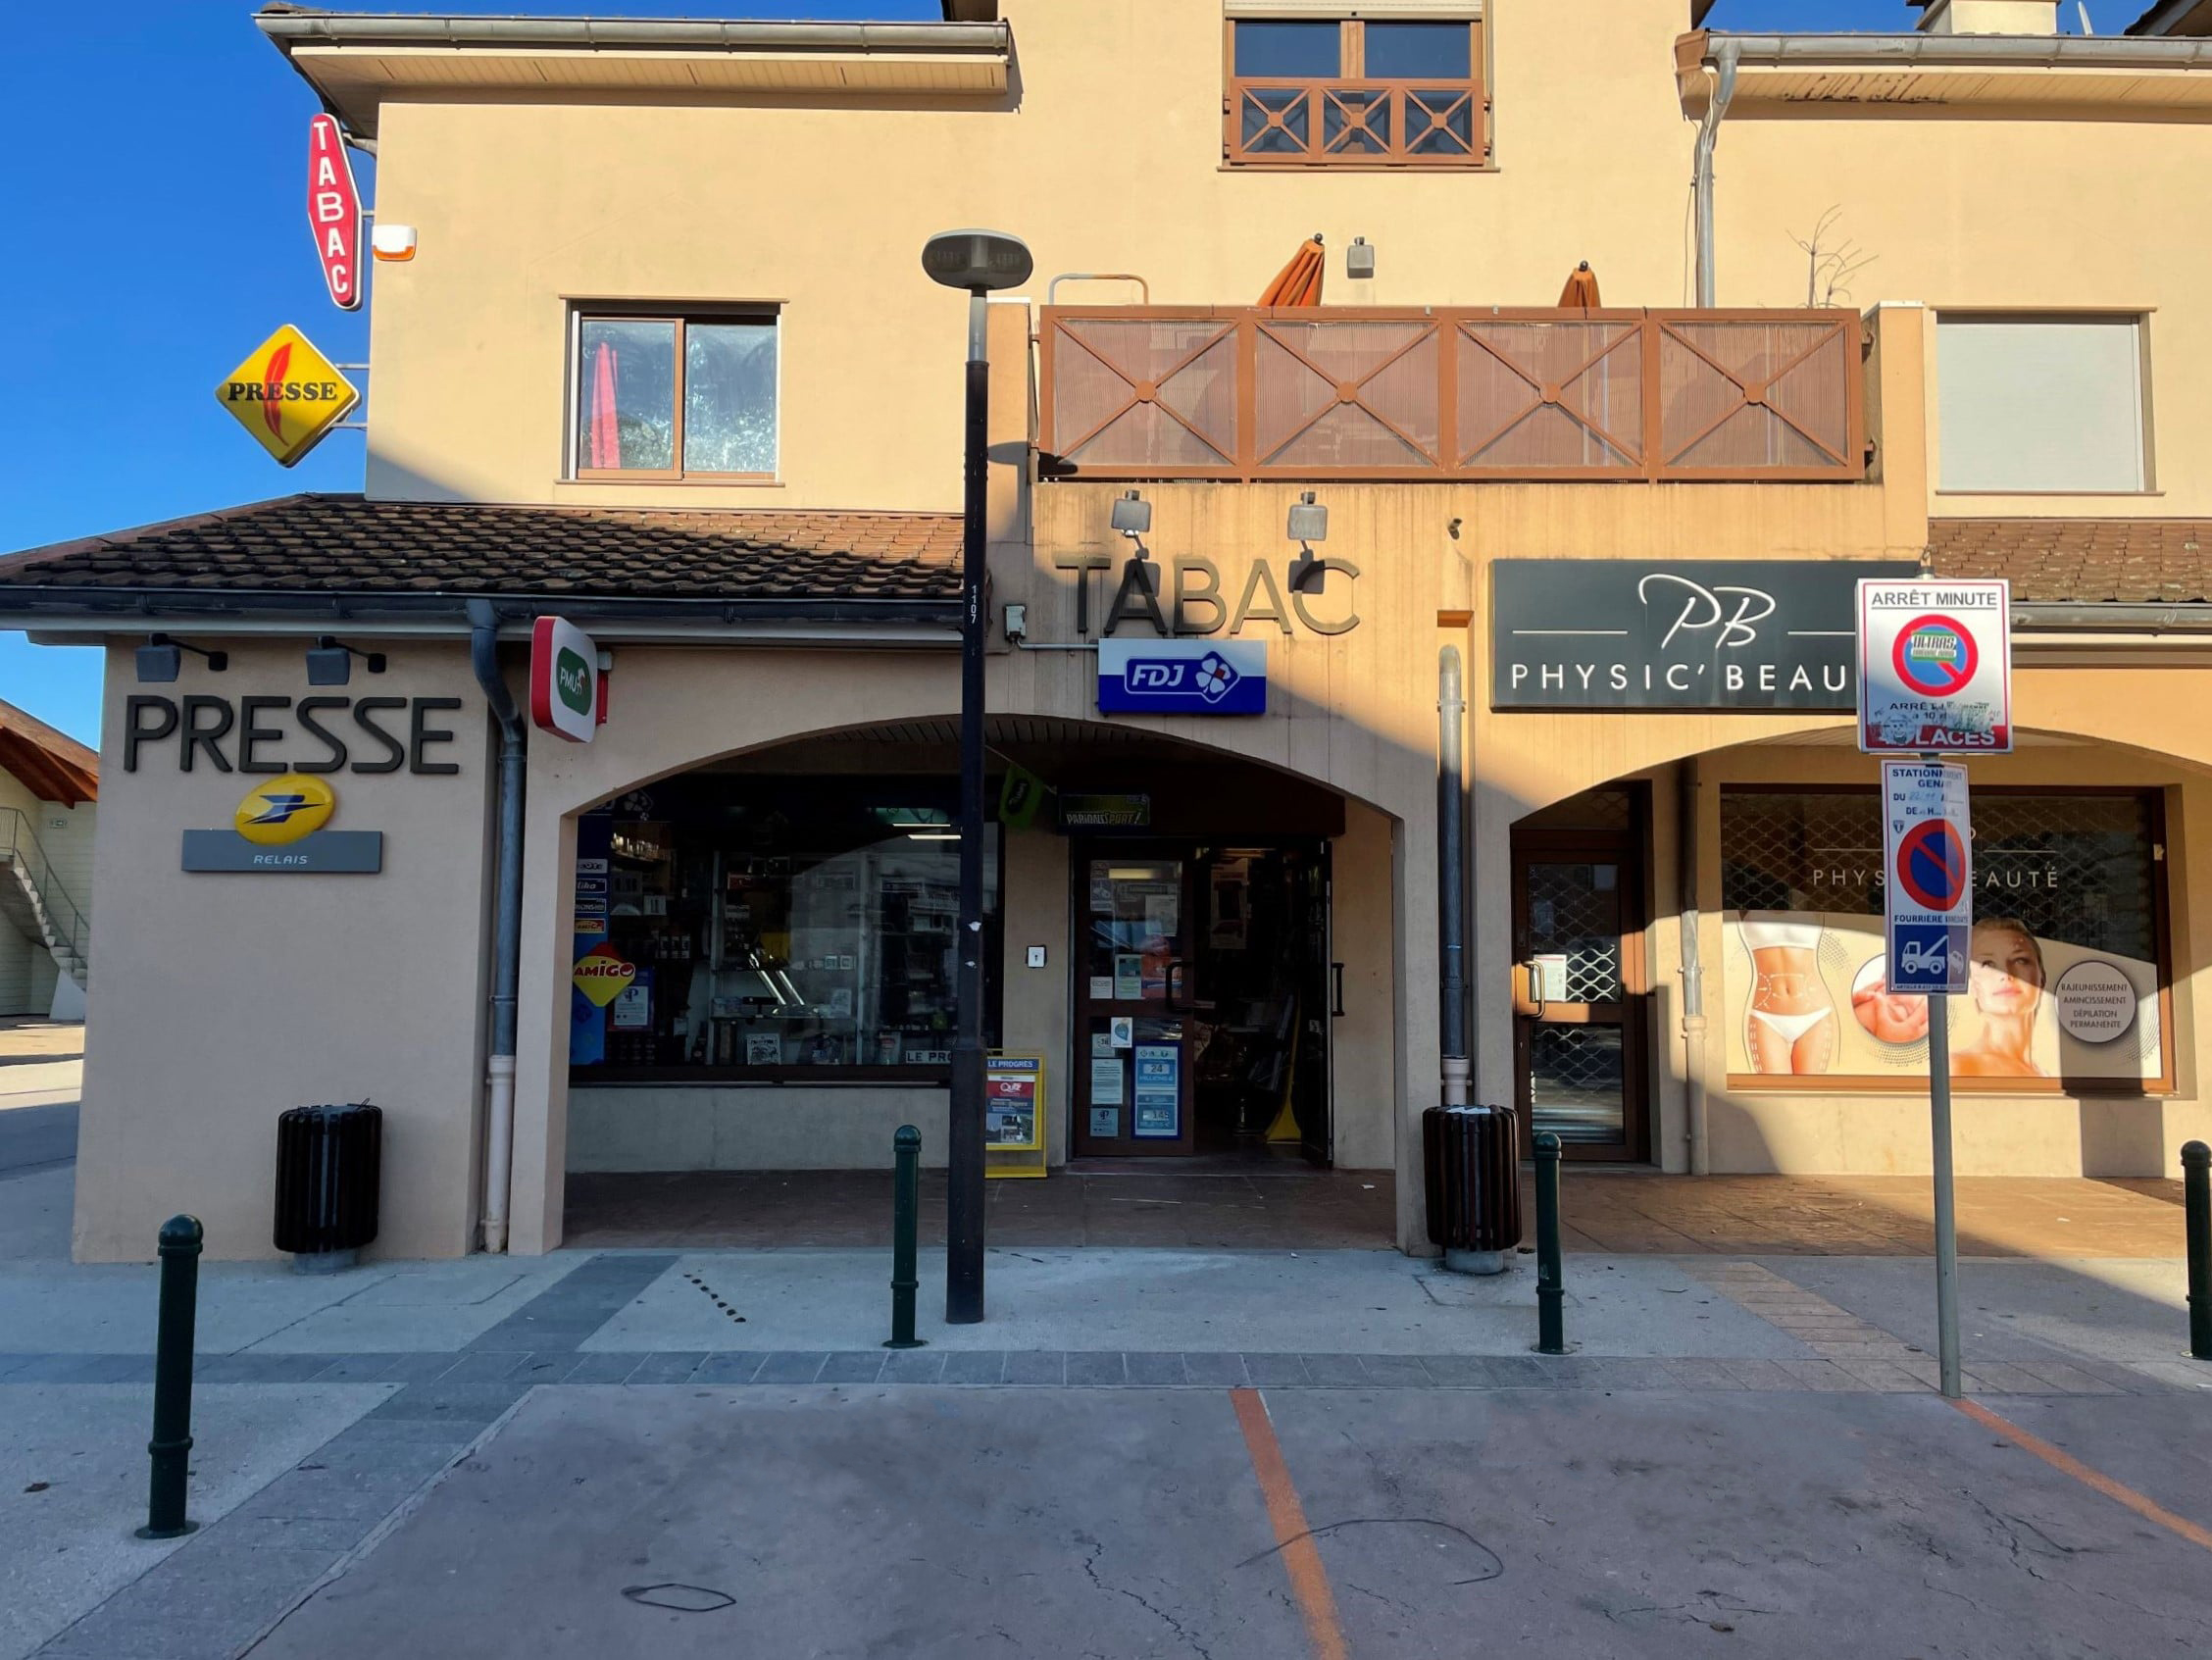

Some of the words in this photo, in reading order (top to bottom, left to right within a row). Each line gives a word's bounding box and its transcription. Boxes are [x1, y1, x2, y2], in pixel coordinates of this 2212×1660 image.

[314, 122, 348, 294] TABAC
[227, 381, 337, 401] PRESSE
[1055, 556, 1361, 635] TABAC
[1872, 589, 1931, 605] ARRÊT
[1936, 592, 1997, 606] MINUTE
[560, 667, 578, 692] PMU
[1131, 664, 1185, 686] FDJ
[124, 694, 462, 775] PRESSE
[1915, 729, 1995, 745] LACES
[253, 854, 308, 865] RELAIS
[1814, 870, 1885, 885] PHYS
[2063, 996, 2126, 1005] AMINCISSEMENT
[2073, 1009, 2118, 1018] DÉPILATION
[907, 1052, 923, 1062] LE
